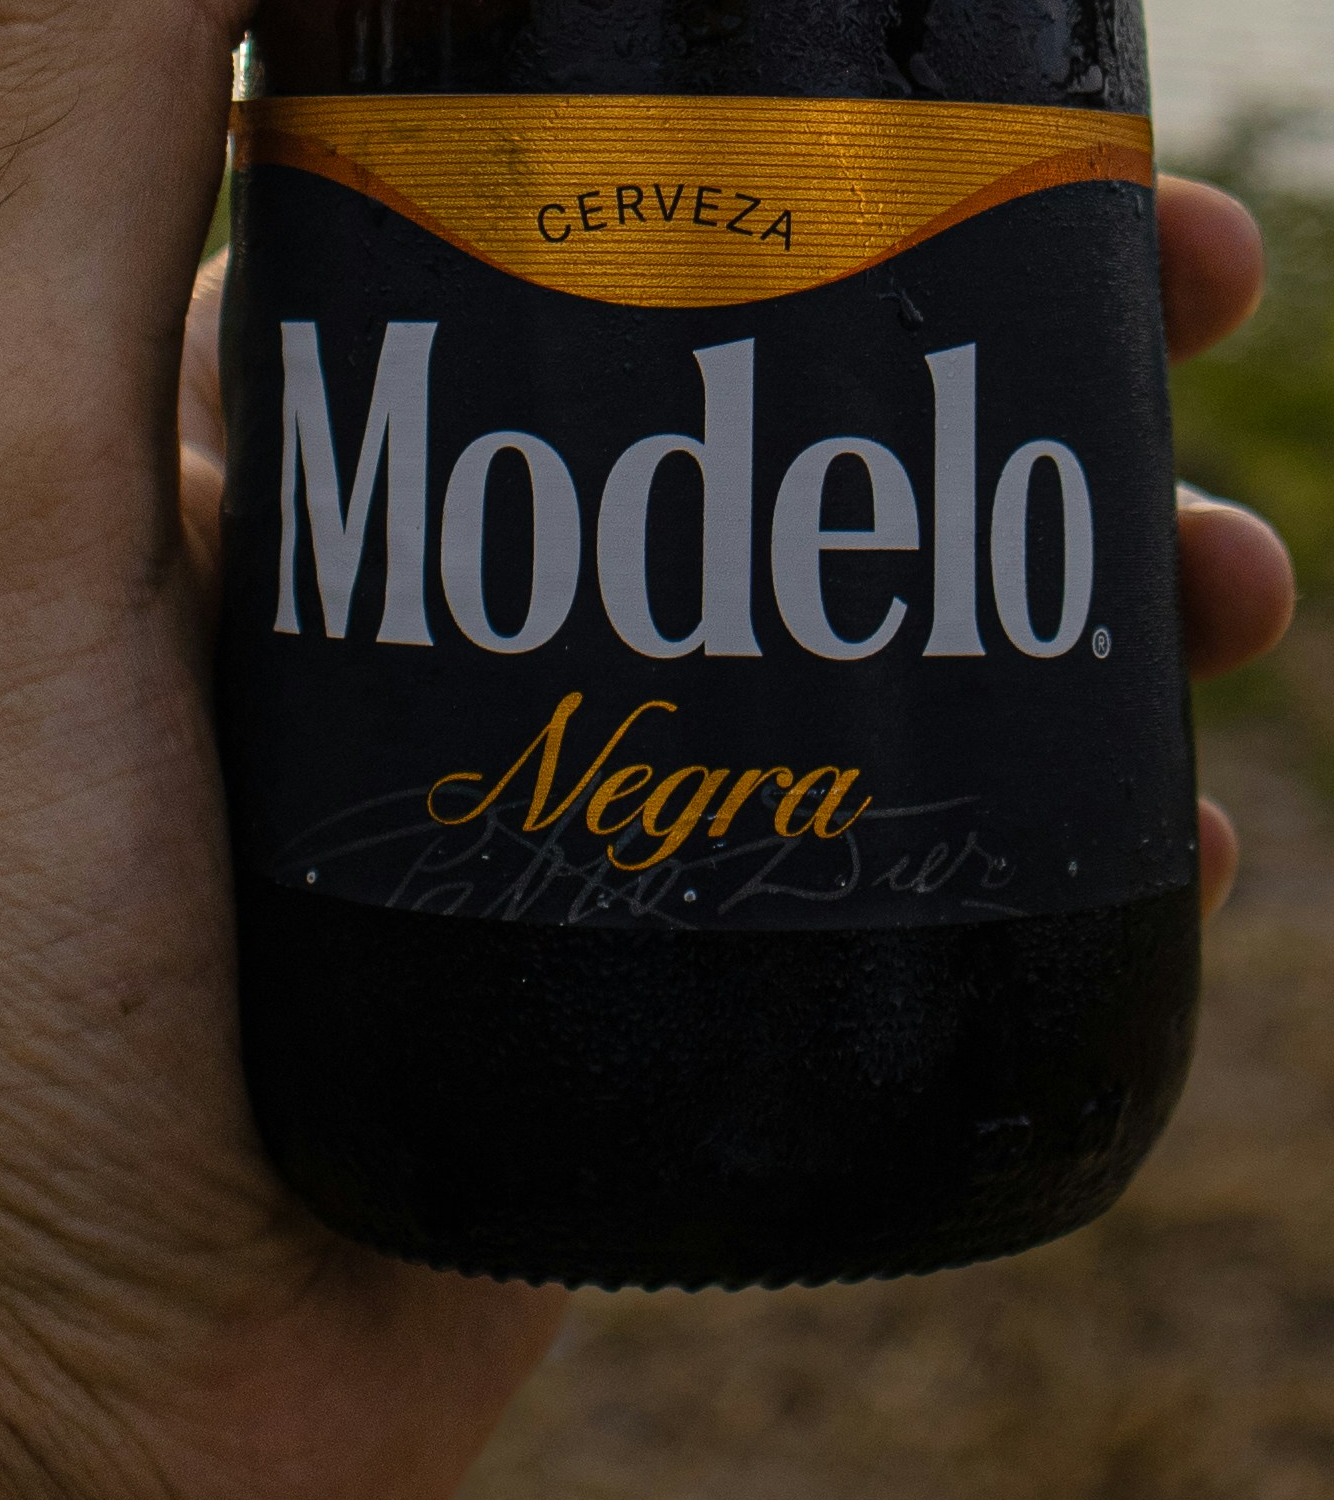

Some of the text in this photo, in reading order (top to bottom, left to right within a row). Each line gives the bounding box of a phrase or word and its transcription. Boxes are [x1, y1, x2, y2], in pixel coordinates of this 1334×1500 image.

[536, 182, 795, 251] CERVEZA
[271, 319, 1096, 661] Modelo
[426, 690, 873, 872] Negra
